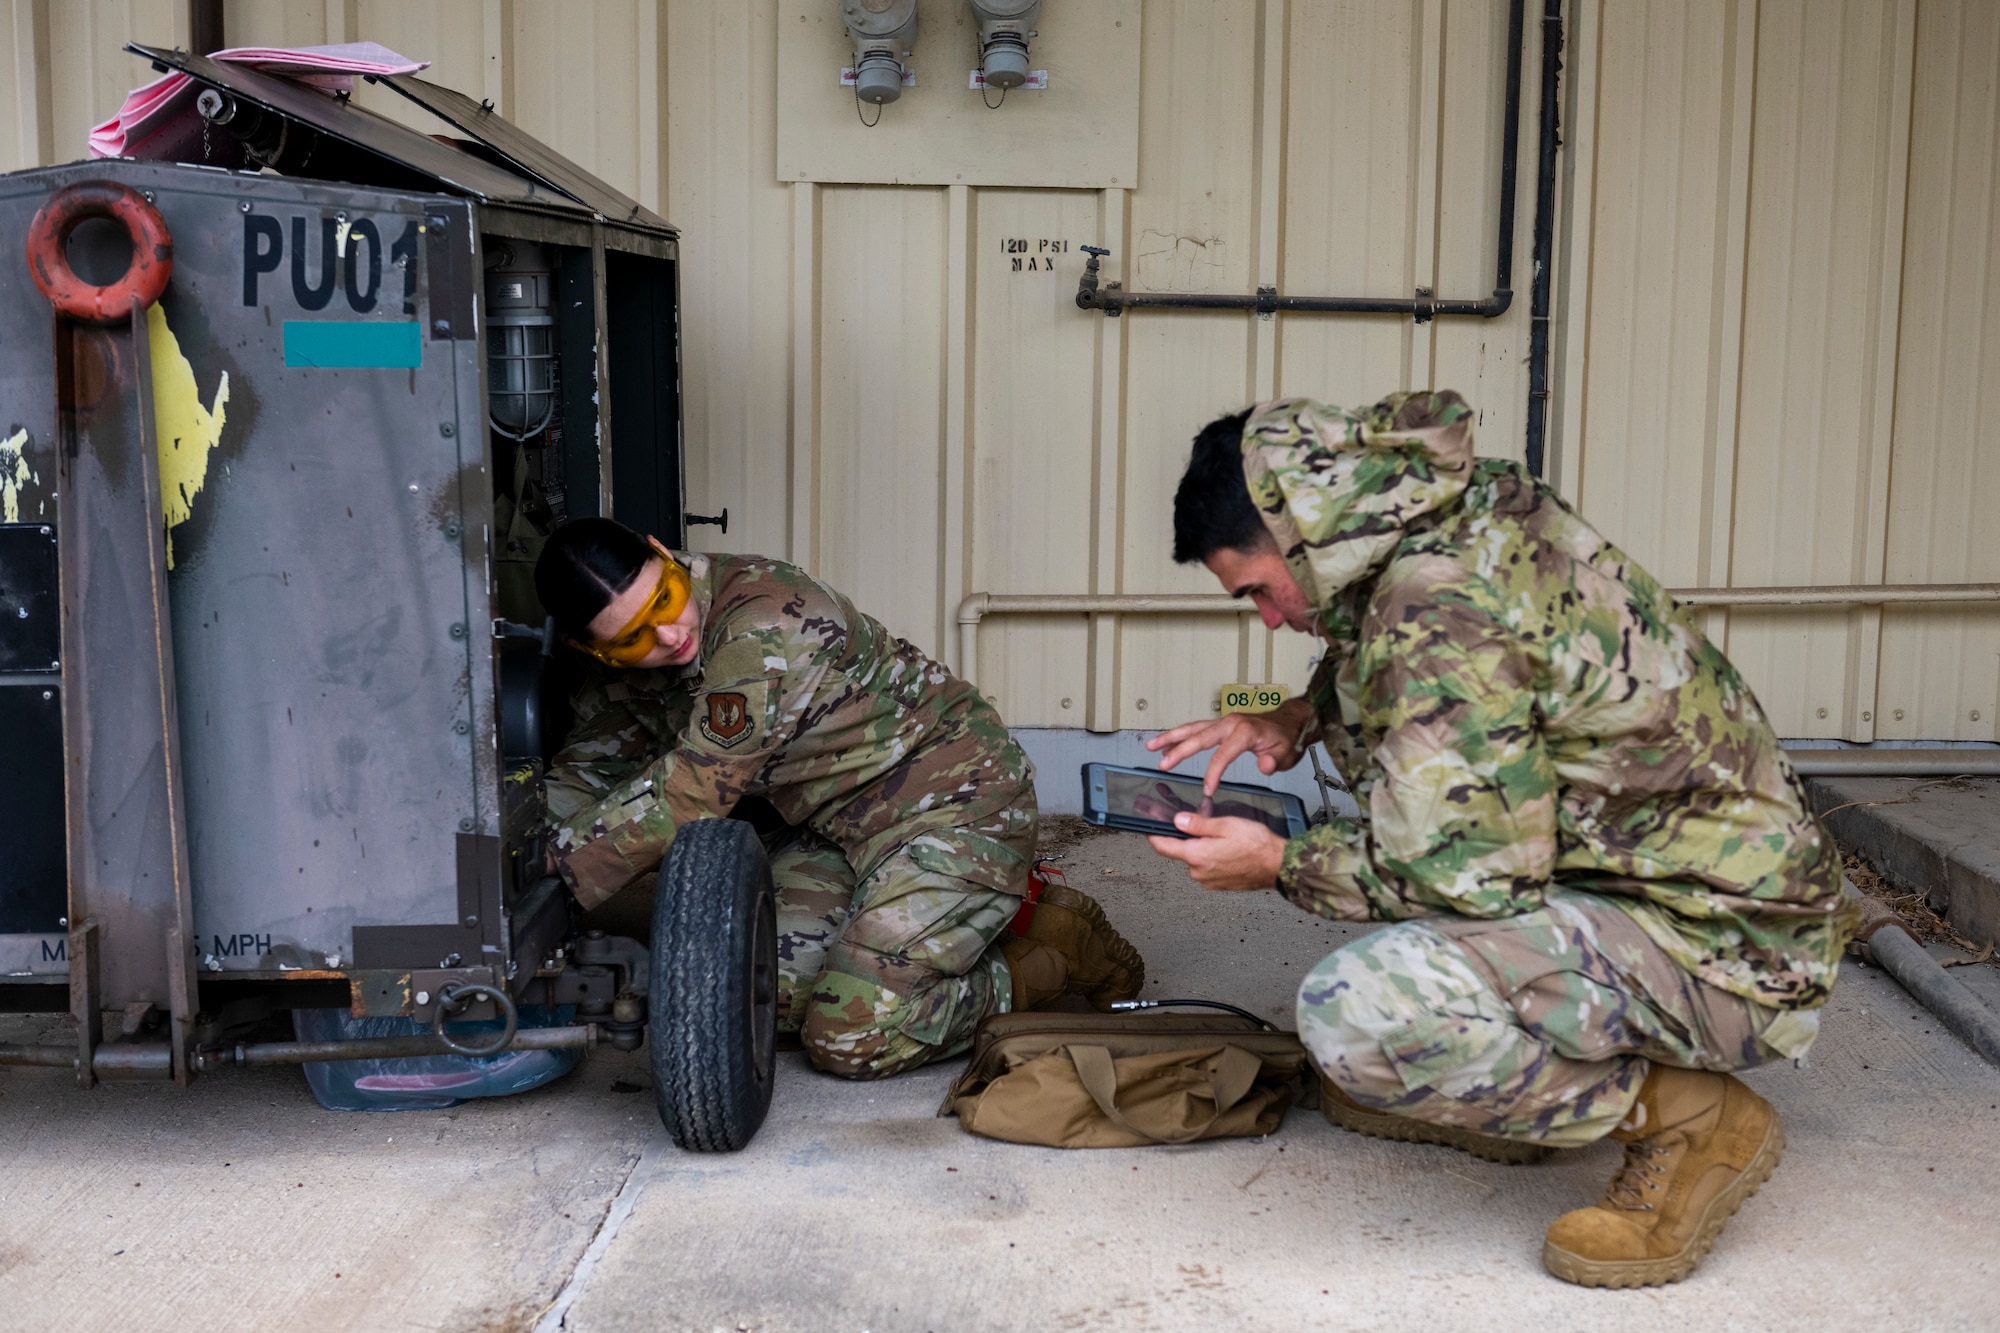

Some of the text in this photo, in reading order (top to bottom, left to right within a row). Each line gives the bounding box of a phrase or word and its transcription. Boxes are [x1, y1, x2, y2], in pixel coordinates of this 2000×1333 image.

[1001, 238, 1067, 253] 120 PSI
[243, 214, 419, 315] PU01
[1011, 257, 1054, 271] MAX
[1226, 691, 1281, 708] 08/99
[214, 933, 272, 957] MPH
